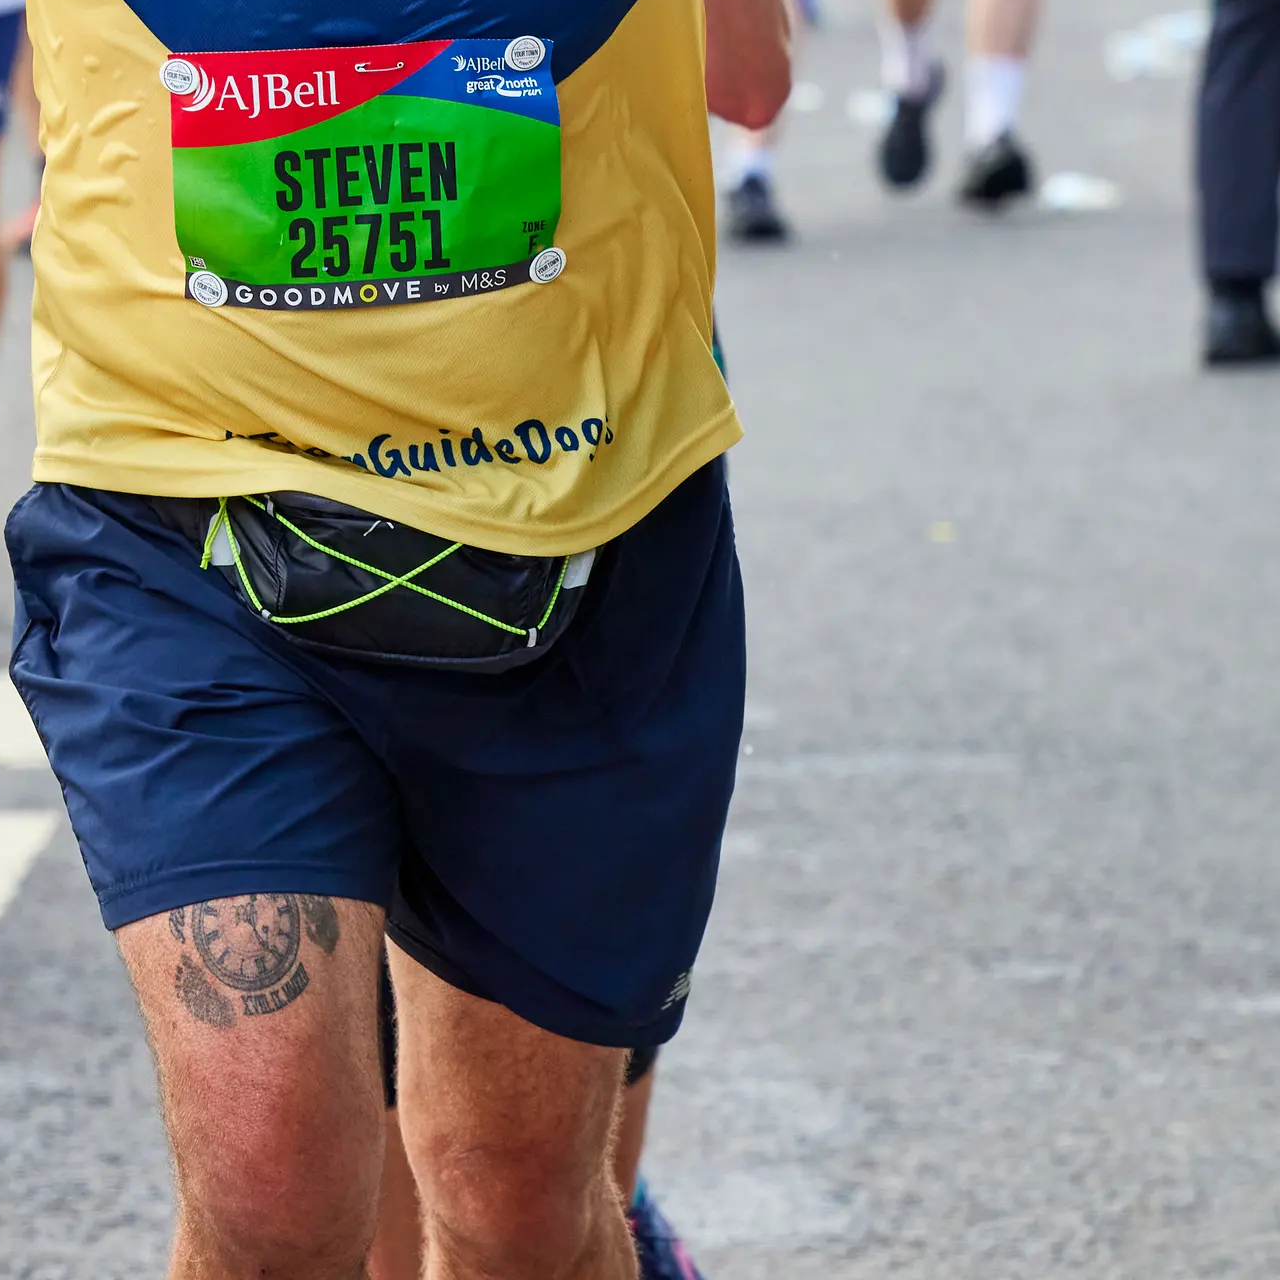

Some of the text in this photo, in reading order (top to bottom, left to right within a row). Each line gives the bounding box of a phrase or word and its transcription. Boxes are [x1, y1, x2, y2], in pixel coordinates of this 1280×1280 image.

[466, 76, 538, 94] great north
[522, 87, 541, 97] run
[274, 141, 458, 212] STEVEN
[522, 219, 546, 233] ZONE
[288, 209, 451, 279] 25751
[528, 233, 539, 256] F
[235, 280, 421, 307] GOODMOVE
[434, 281, 450, 295] by
[461, 269, 507, 293] M&S
